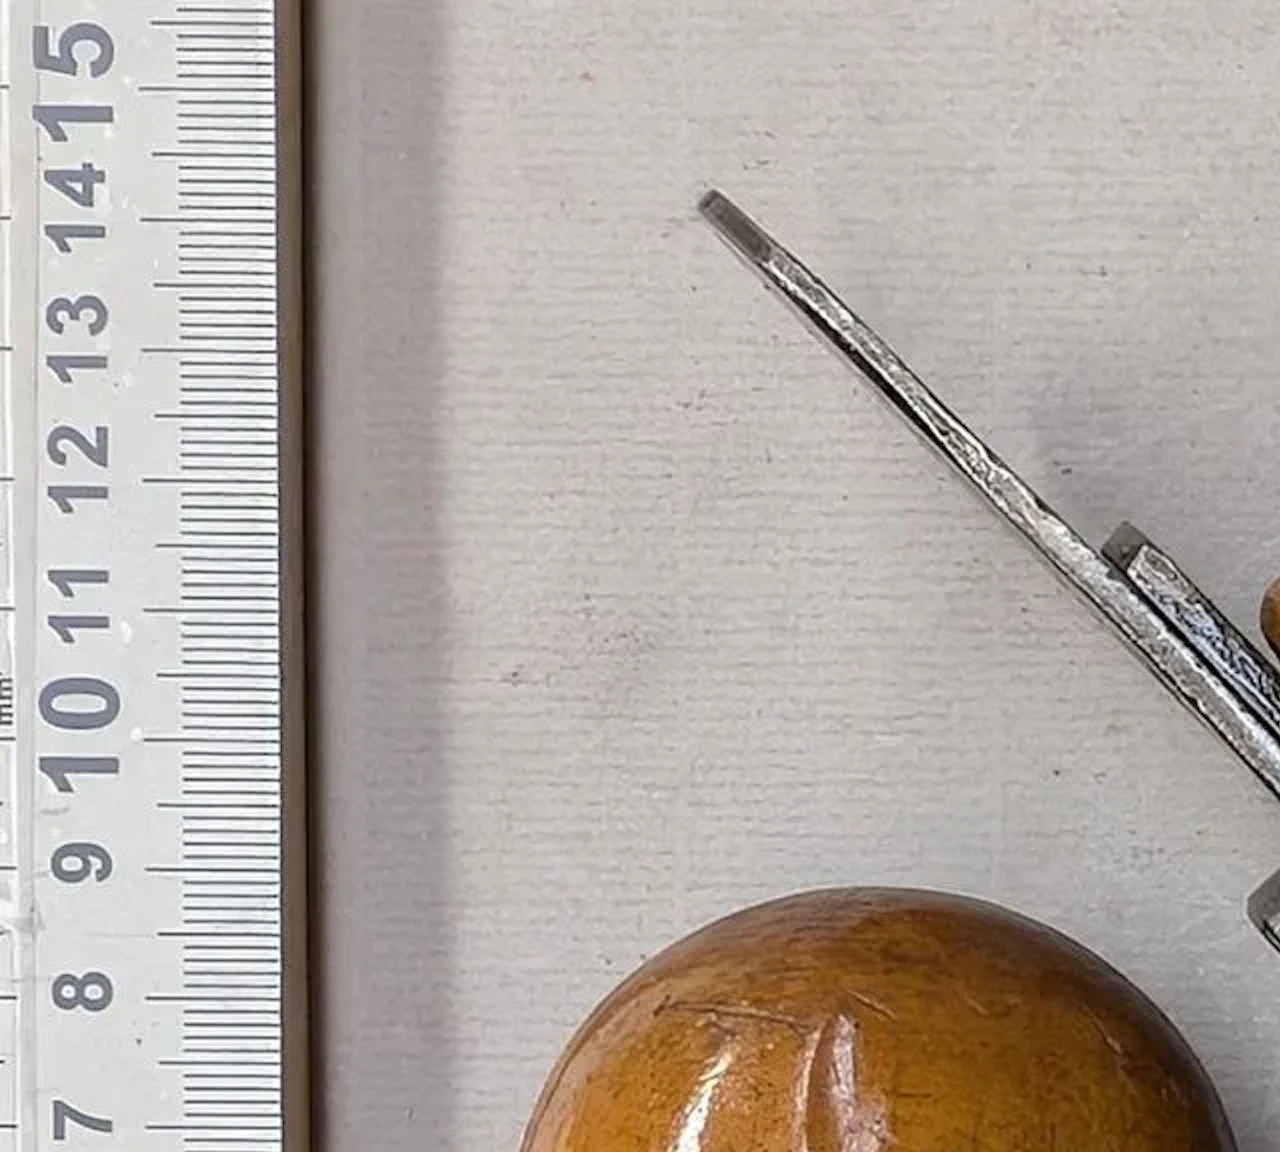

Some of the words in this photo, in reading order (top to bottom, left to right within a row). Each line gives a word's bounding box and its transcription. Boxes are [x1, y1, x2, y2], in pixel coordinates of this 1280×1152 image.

[33, 23, 114, 142] 15
[44, 163, 105, 253] 14
[46, 296, 108, 383] 13
[47, 426, 108, 513] 12
[48, 570, 109, 643] 11
[39, 678, 120, 792] 10
[51, 843, 112, 883] 9
[52, 972, 112, 1011] 8
[53, 1100, 112, 1140] 7
